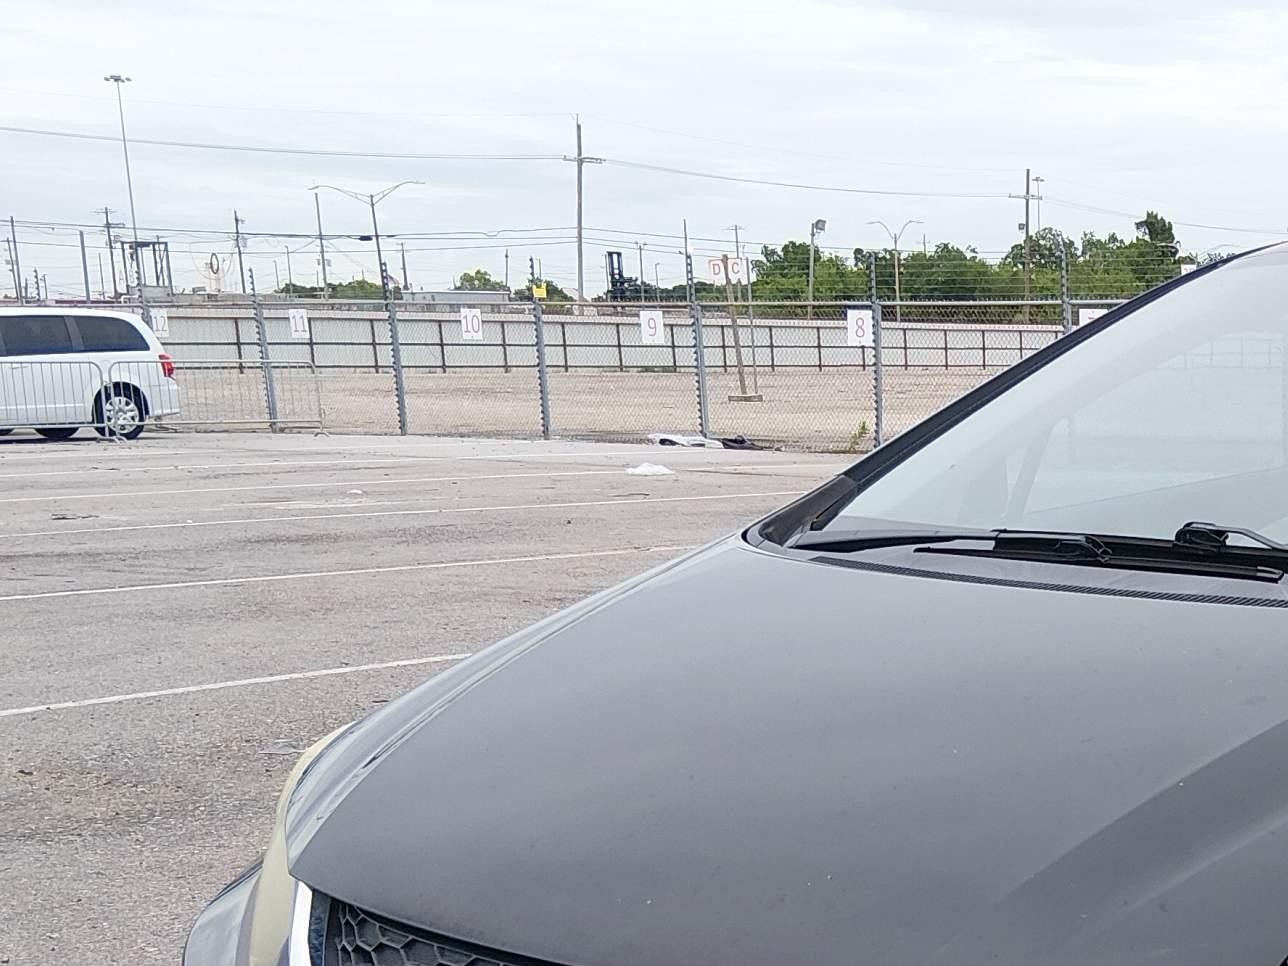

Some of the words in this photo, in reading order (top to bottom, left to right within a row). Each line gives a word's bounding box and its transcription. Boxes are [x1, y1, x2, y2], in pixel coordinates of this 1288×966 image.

[712, 263, 721, 276] D
[731, 262, 740, 274] C
[153, 315, 168, 333] 12
[292, 314, 307, 333] 11
[463, 313, 480, 334] 10
[646, 317, 657, 337] 9
[855, 316, 865, 338] 8
